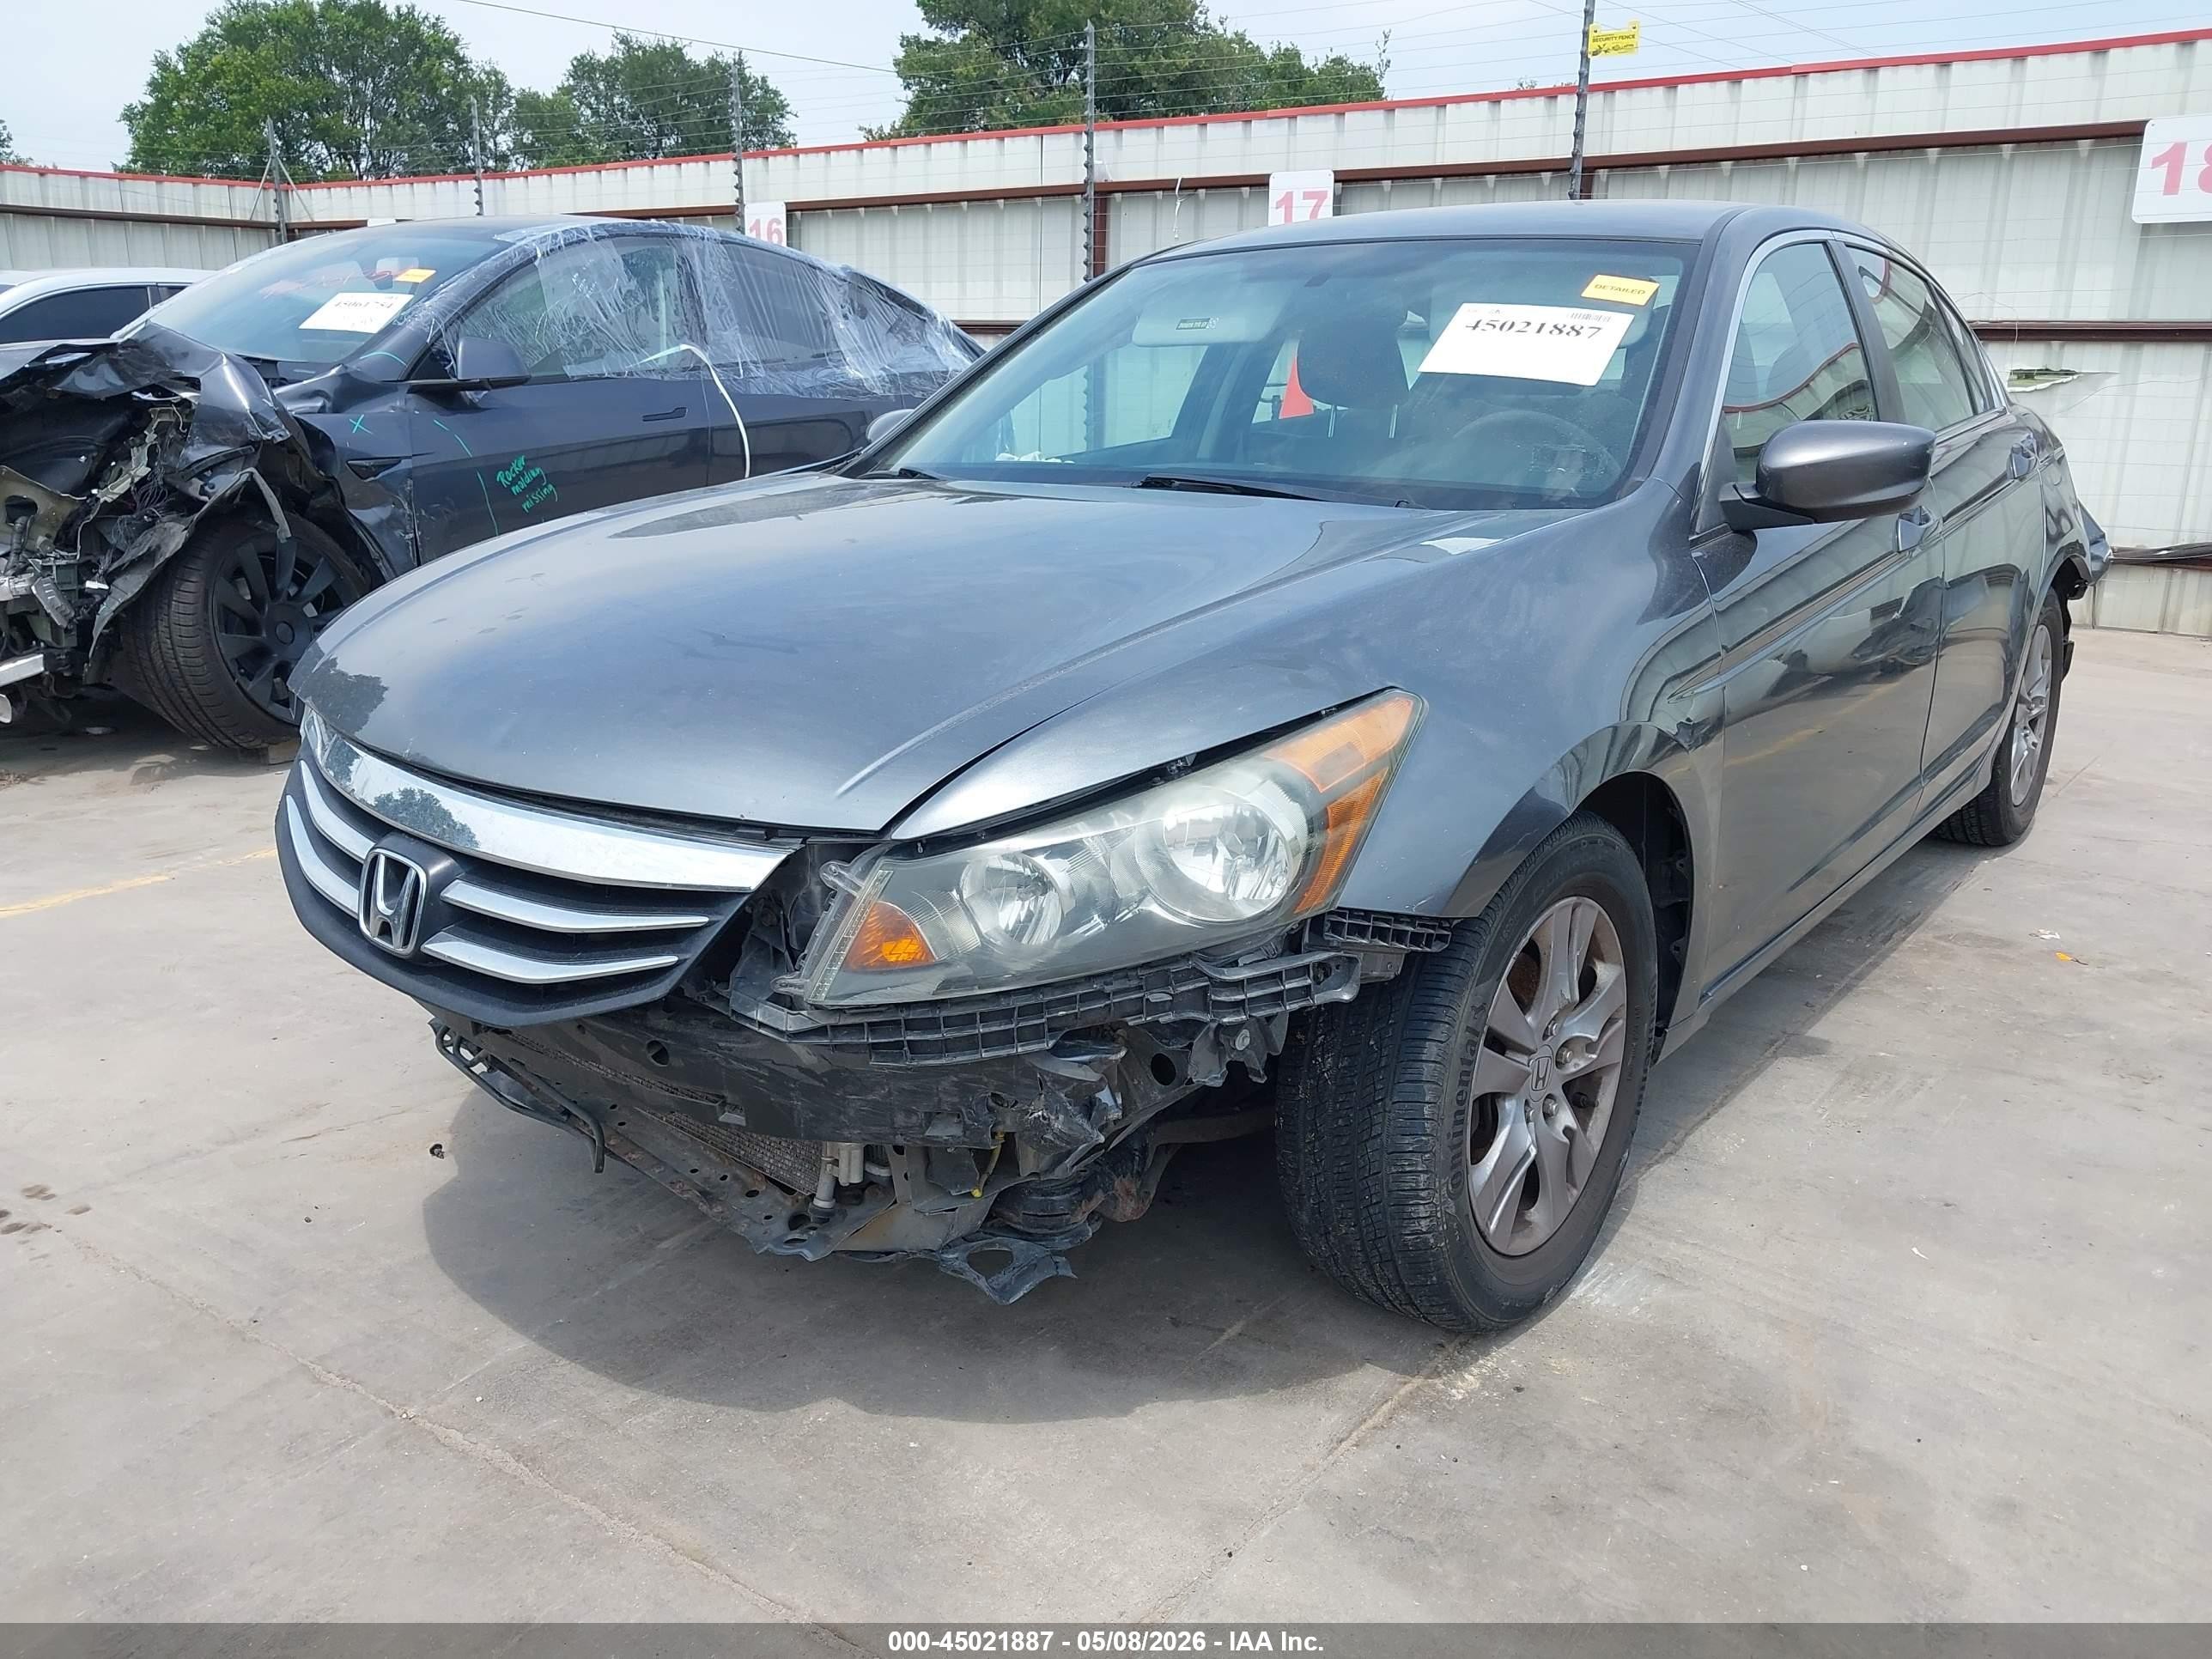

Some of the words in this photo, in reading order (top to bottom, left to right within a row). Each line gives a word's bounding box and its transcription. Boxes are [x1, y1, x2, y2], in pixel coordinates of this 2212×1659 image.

[2151, 141, 2212, 196] 1
[1275, 191, 1328, 225] 17
[749, 217, 784, 246] 16
[1594, 283, 1646, 295] DETAILED
[1465, 319, 1603, 339] 45021887
